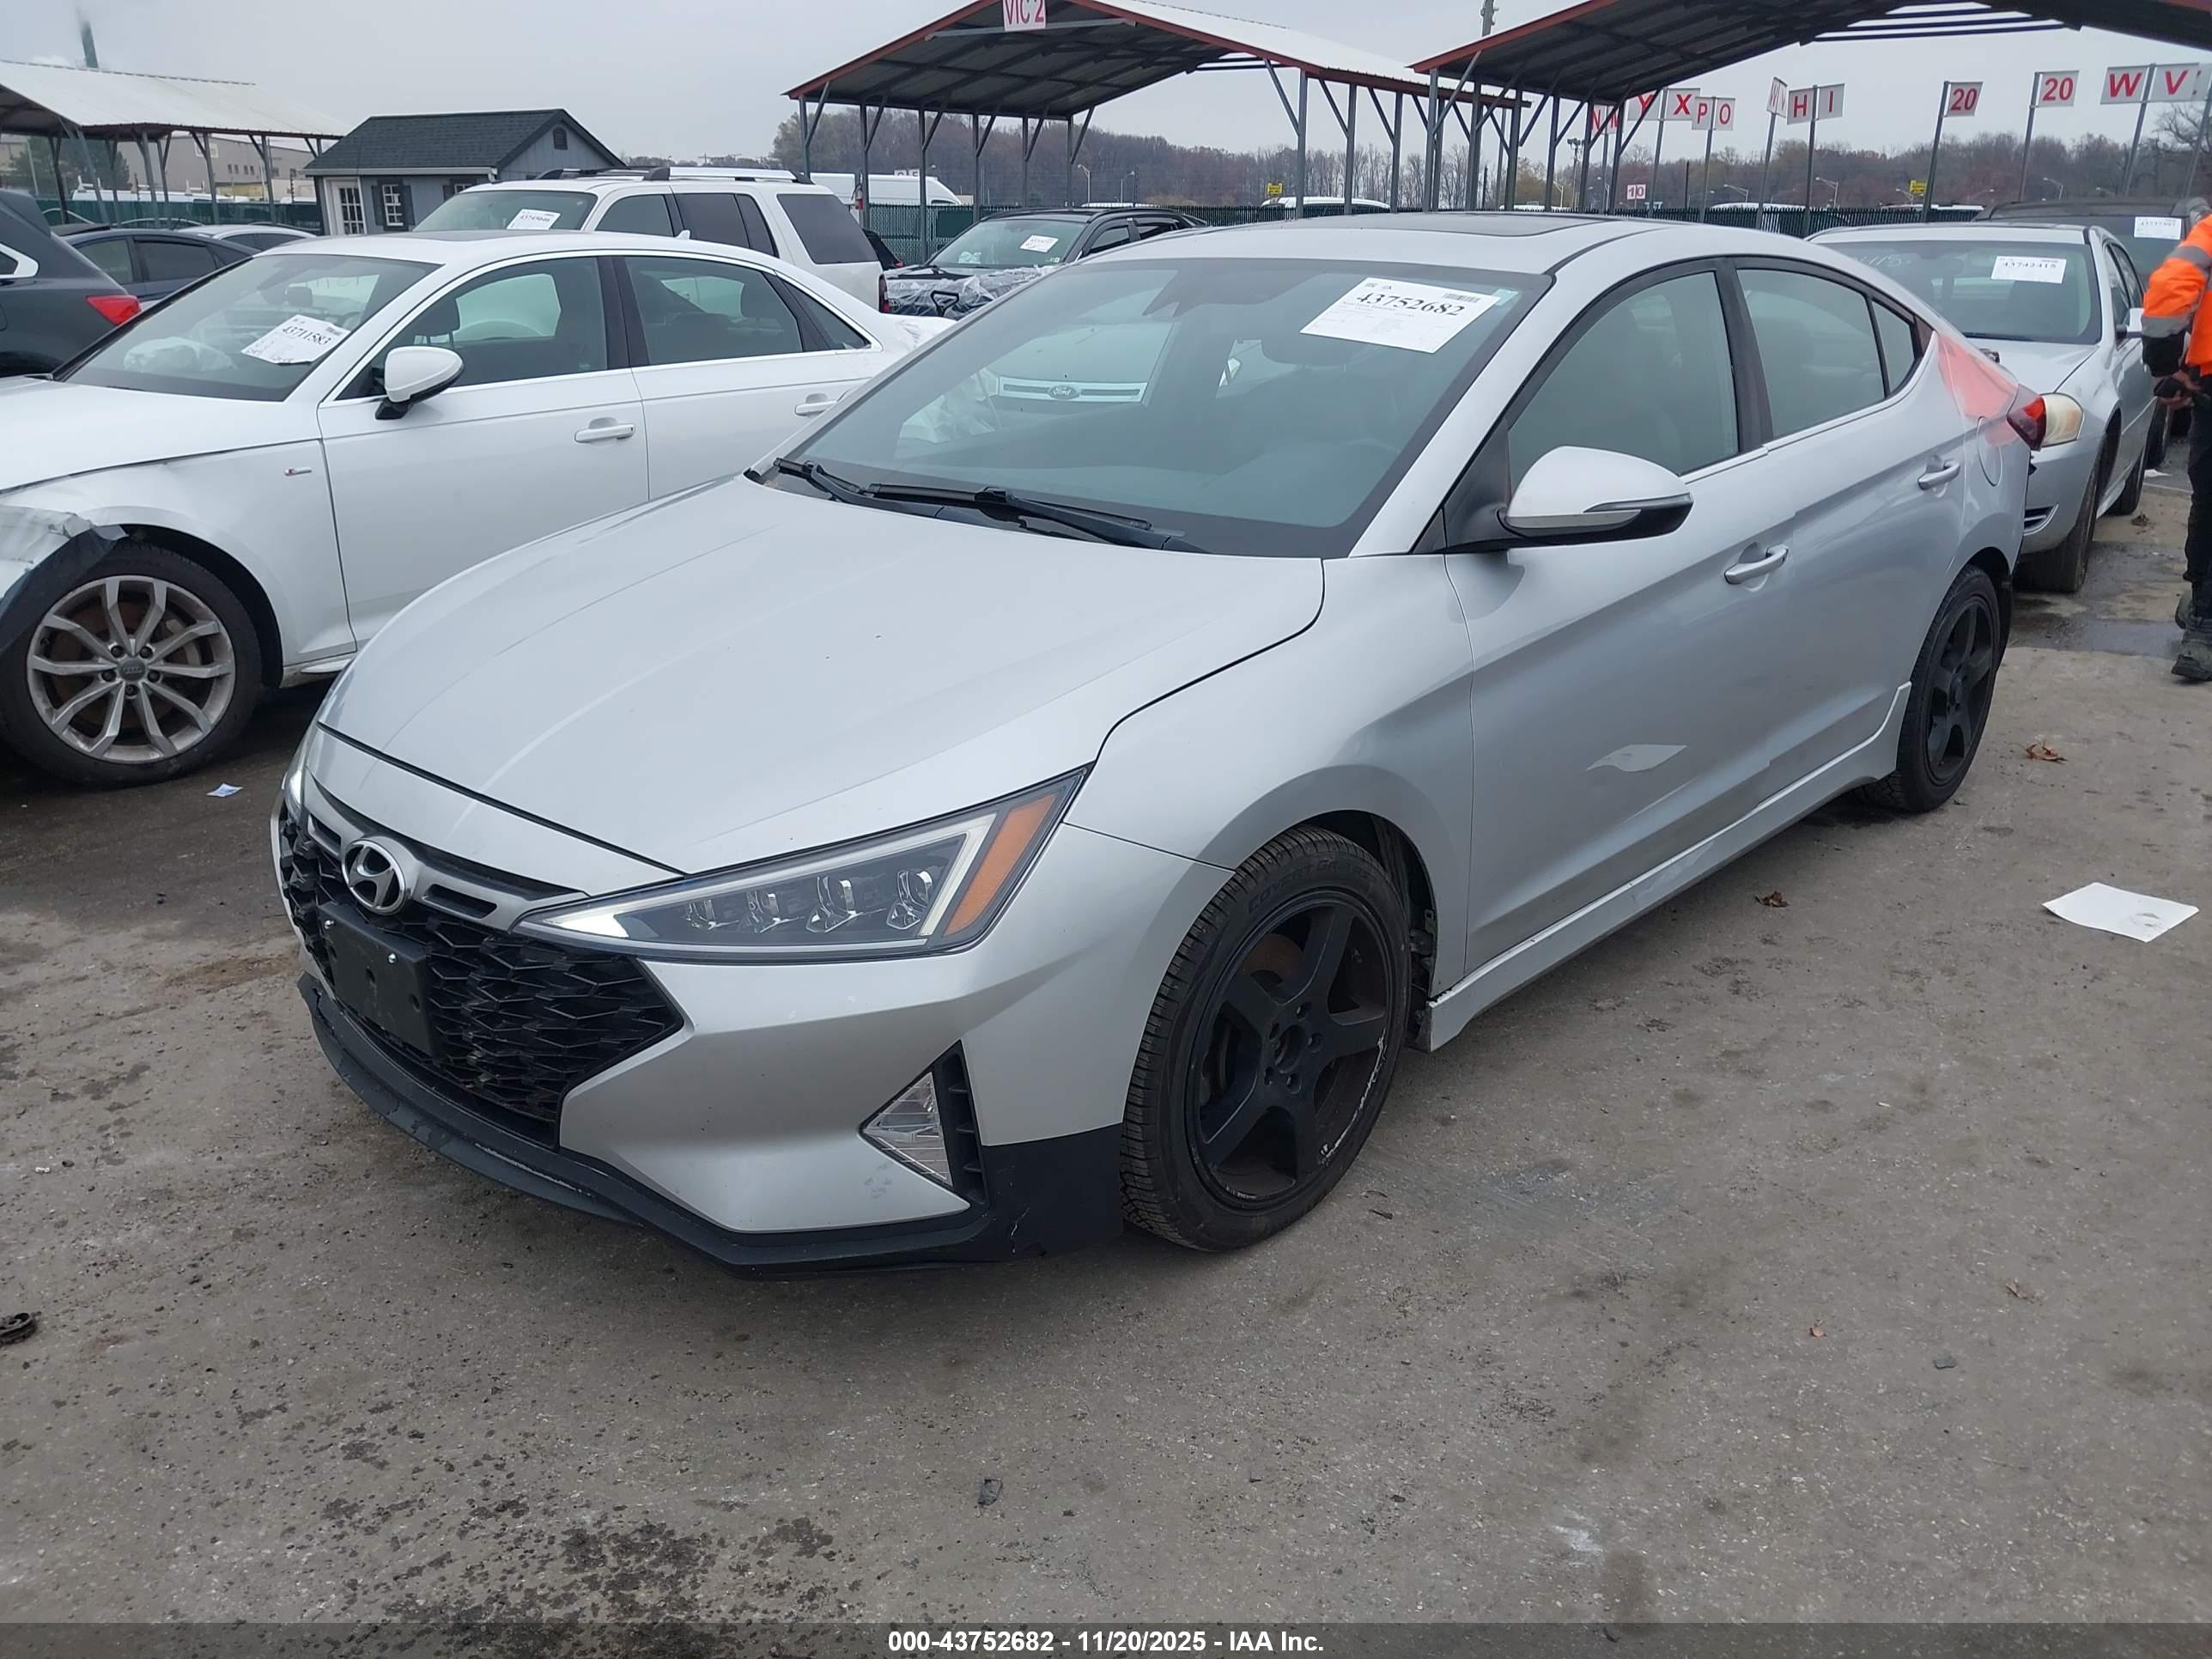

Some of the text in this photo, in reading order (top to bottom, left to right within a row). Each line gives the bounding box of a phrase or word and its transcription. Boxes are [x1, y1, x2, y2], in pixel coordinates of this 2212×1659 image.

[1005, 0, 1045, 25] VIC 2
[2042, 77, 2074, 101] 20
[2110, 70, 2189, 98] W V
[1674, 94, 1692, 115] X
[1793, 90, 1834, 118] H I
[1950, 88, 1978, 111] 20
[1697, 103, 1731, 125] P O
[1628, 185, 1644, 198] 10
[1356, 292, 1465, 316] 43752682
